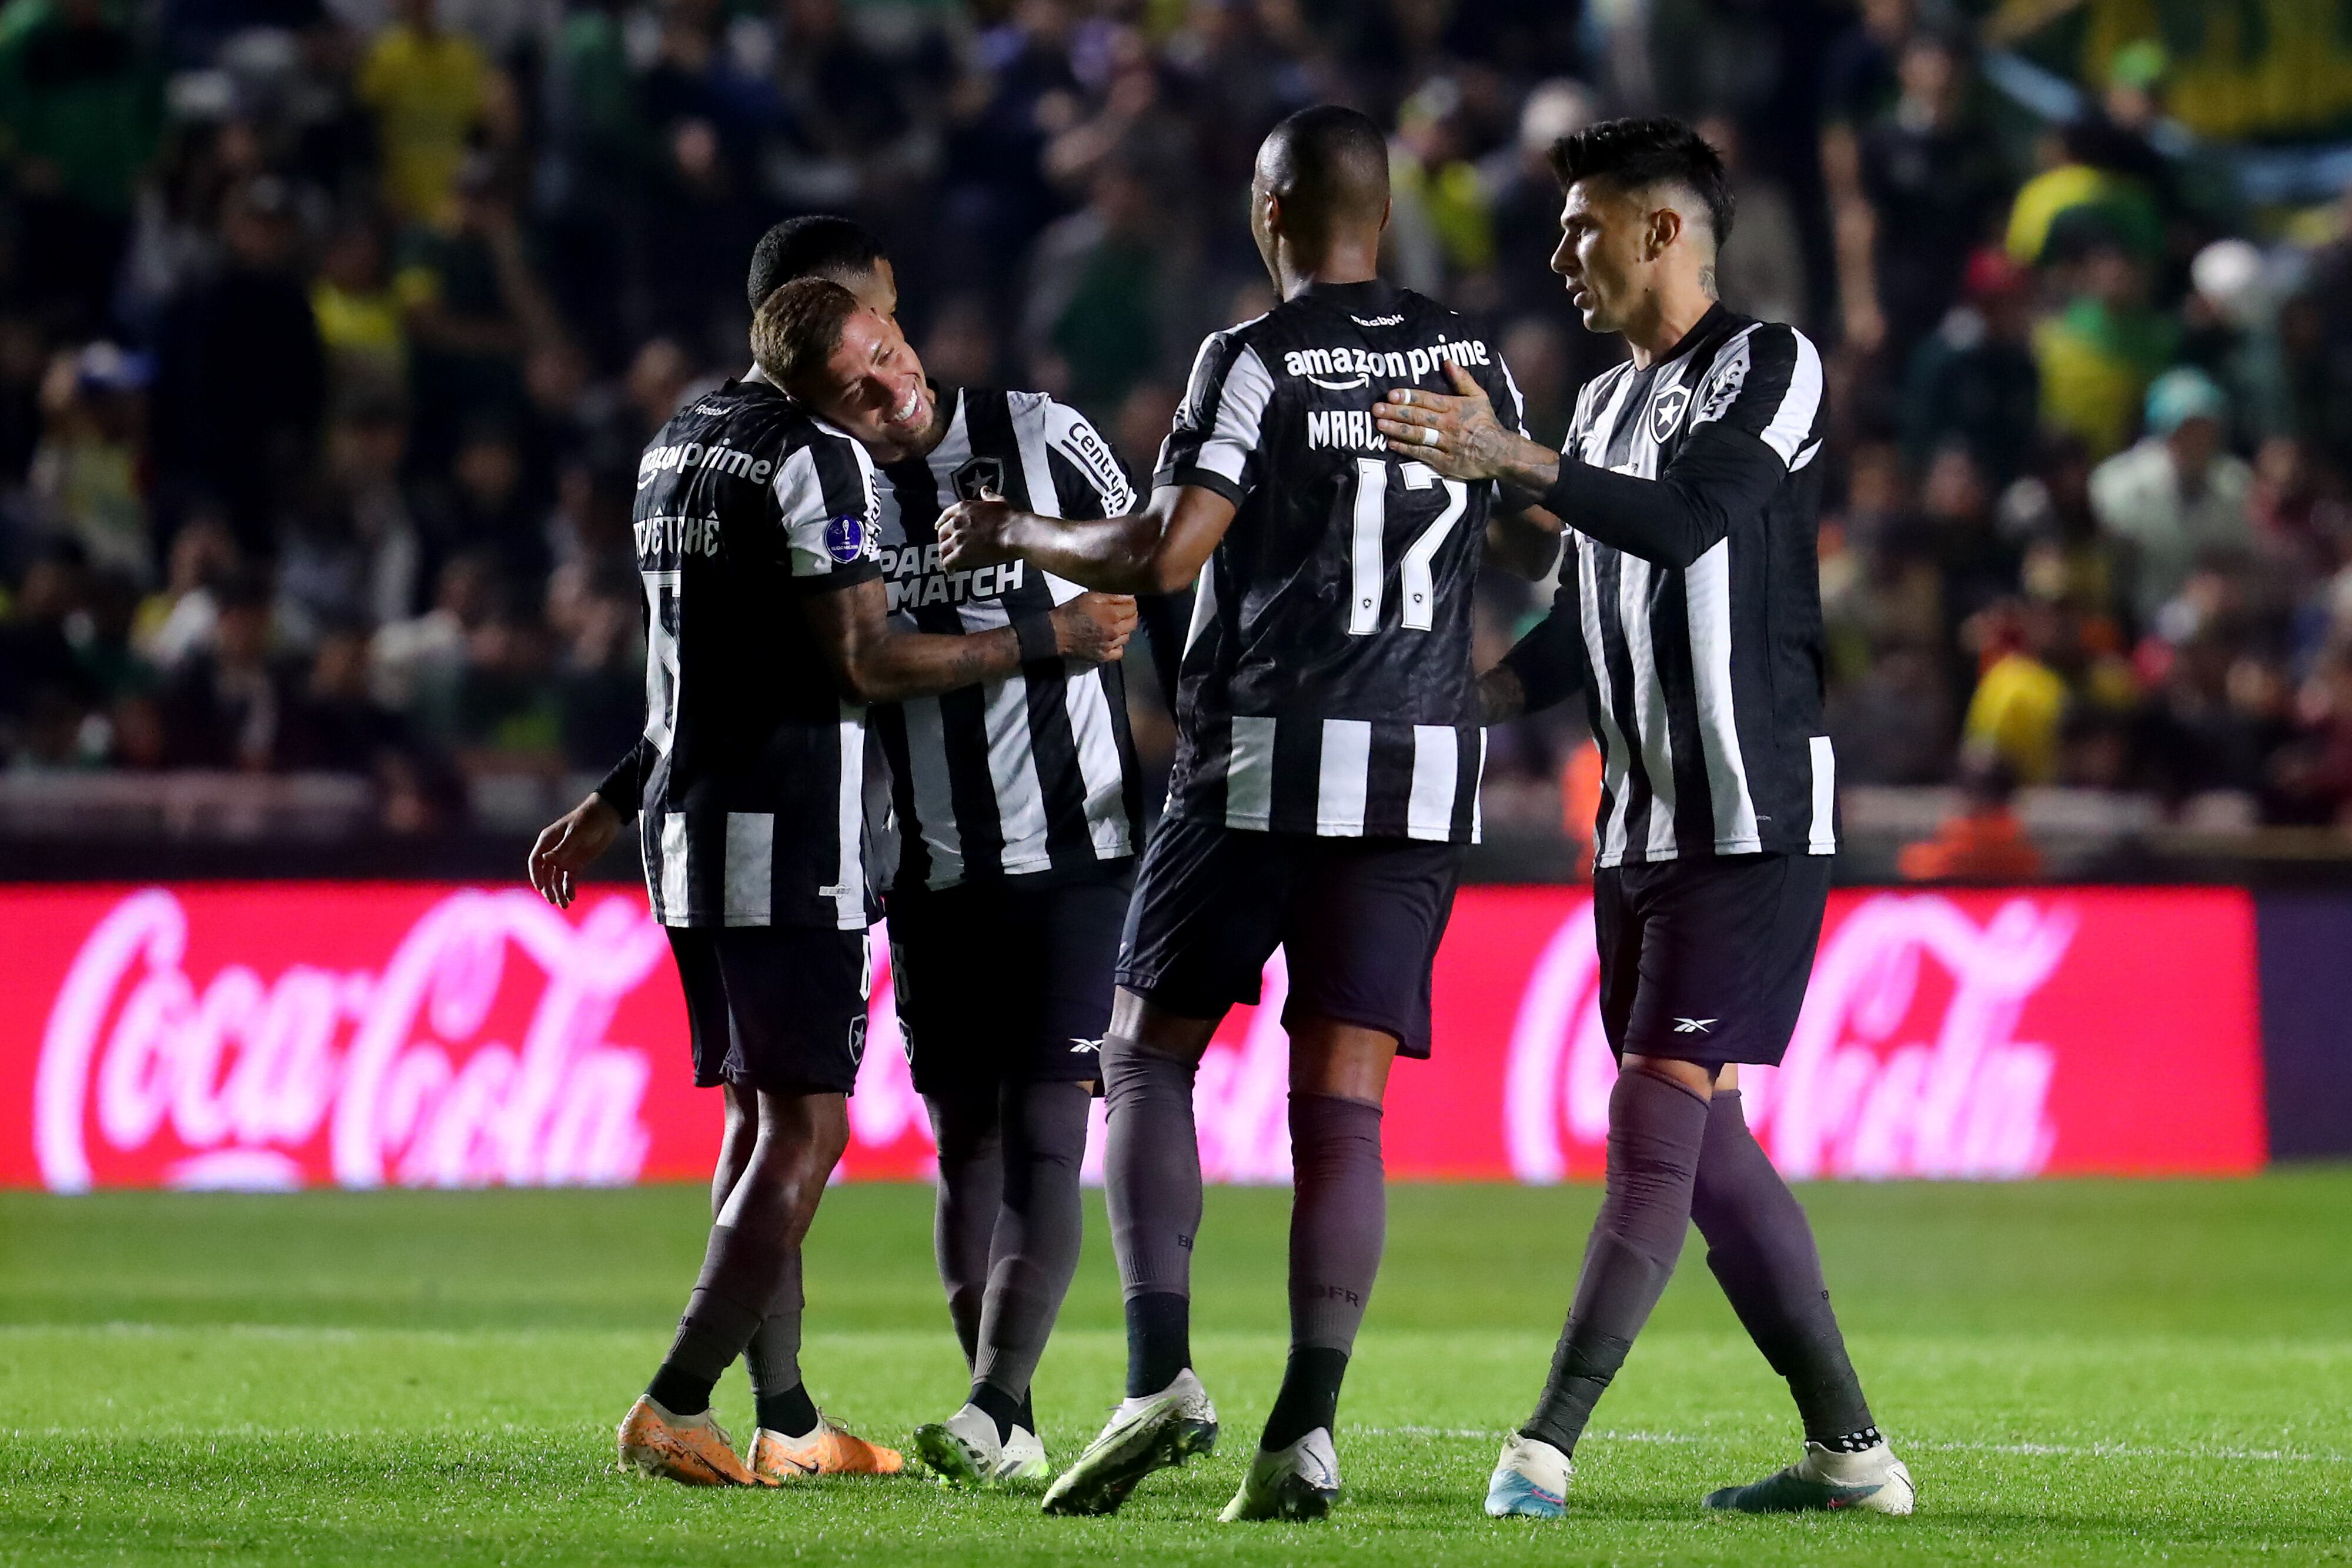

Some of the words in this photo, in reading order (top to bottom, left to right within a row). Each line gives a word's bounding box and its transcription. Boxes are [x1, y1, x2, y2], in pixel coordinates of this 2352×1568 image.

[1284, 347, 1406, 377] amazon
[1406, 333, 1491, 385] prime
[1307, 410, 1388, 452] MARL
[676, 437, 771, 484] prime
[1068, 422, 1128, 511] Centrum
[880, 543, 944, 579] PAR
[1348, 457, 1468, 637] 17
[884, 558, 1024, 611] MATCH
